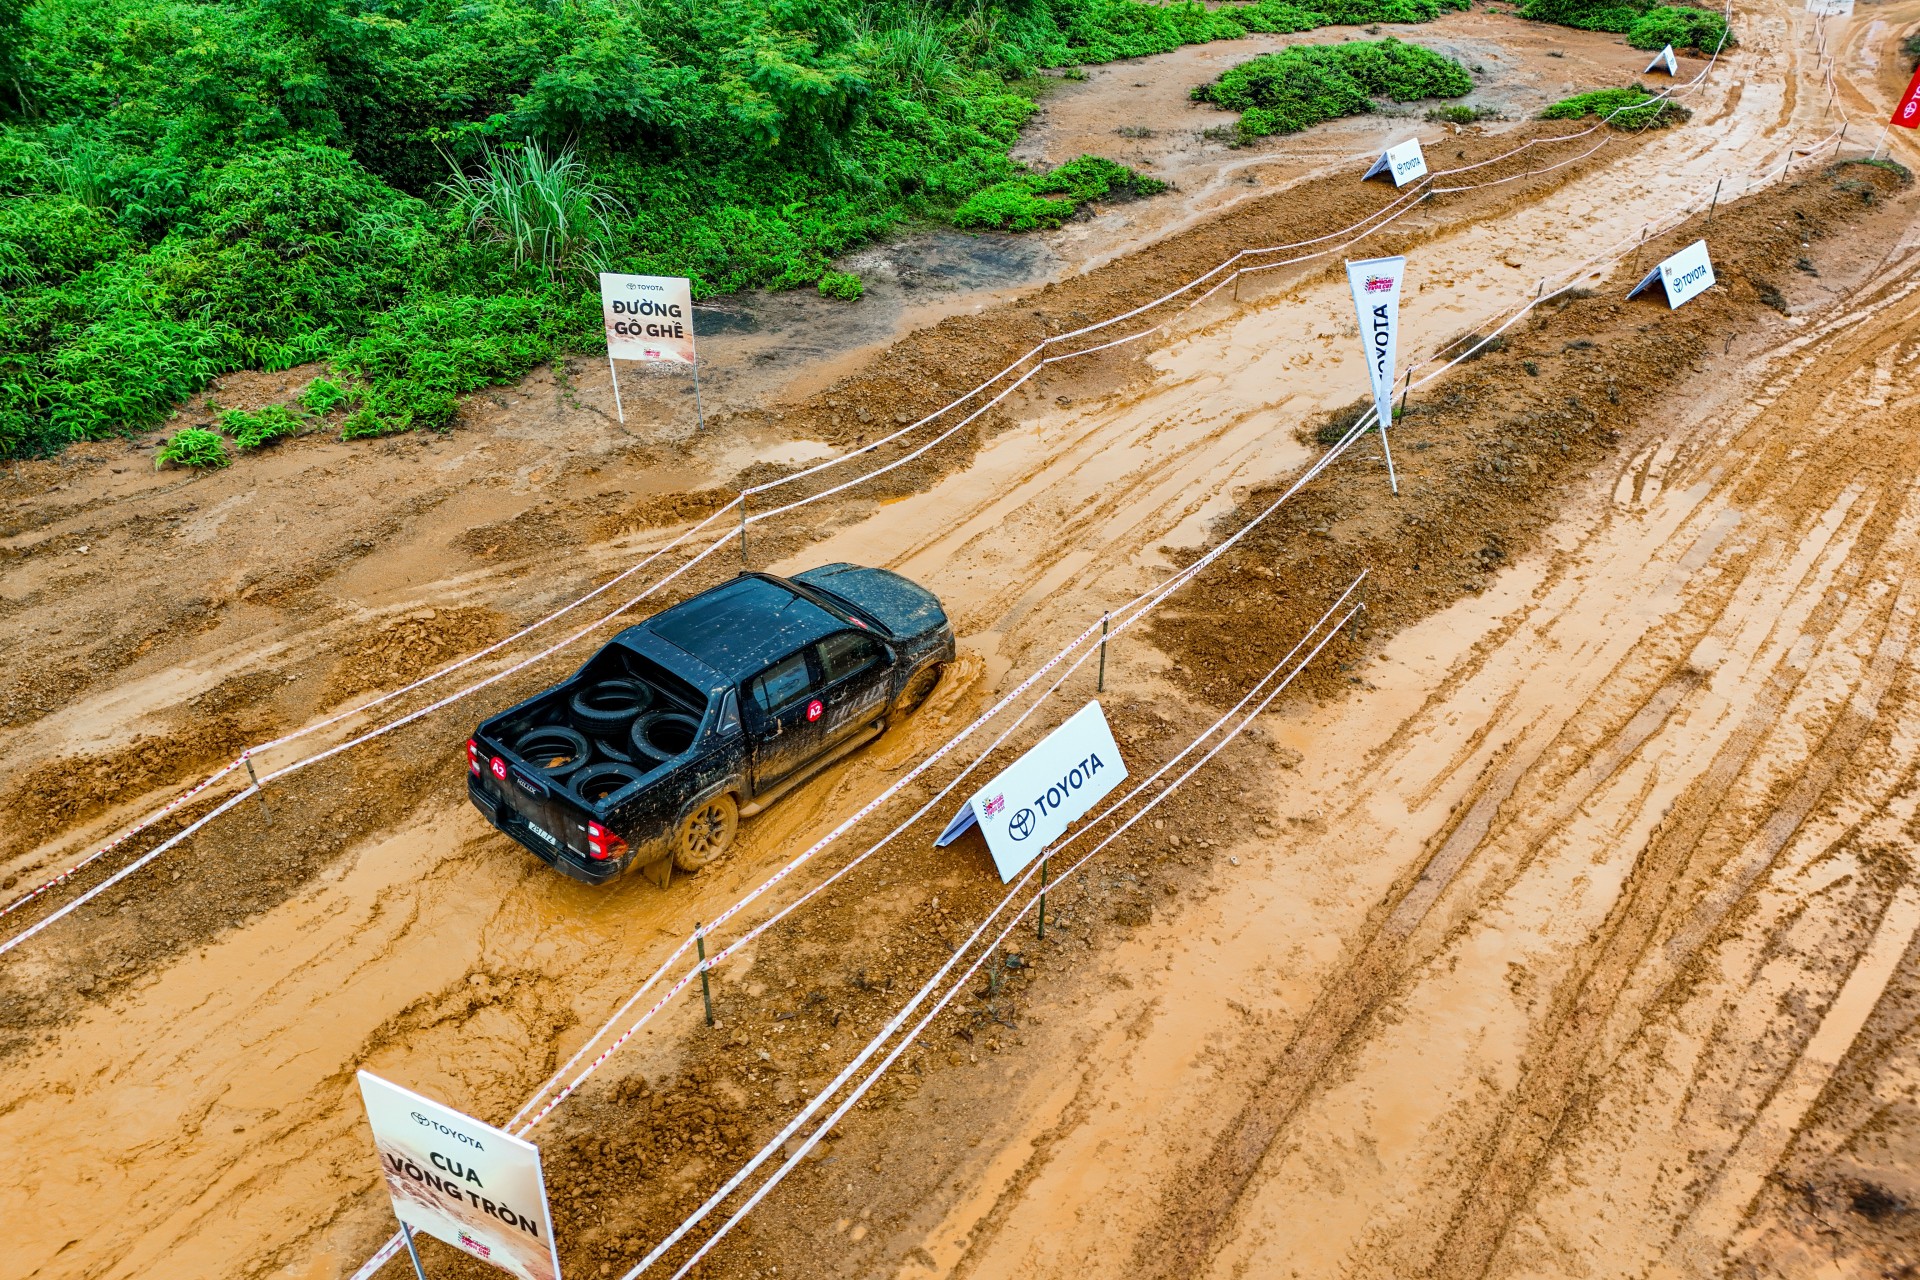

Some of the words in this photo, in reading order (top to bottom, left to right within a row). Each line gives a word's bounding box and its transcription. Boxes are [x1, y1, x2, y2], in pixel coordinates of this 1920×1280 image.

[1682, 264, 1707, 287] TOYOTA
[637, 284, 665, 292] TOYOTA
[612, 298, 682, 318] ĐƯỜNG
[614, 318, 642, 336] GỒ
[646, 320, 684, 339] GHỀ
[810, 705, 822, 719] A2
[492, 762, 505, 778] A2
[1034, 752, 1104, 817] TOYOTA
[431, 1120, 485, 1152] TOYOTA
[429, 1151, 484, 1189] CUA
[386, 1152, 463, 1202] VÒNG
[466, 1189, 539, 1238] TRÒN
